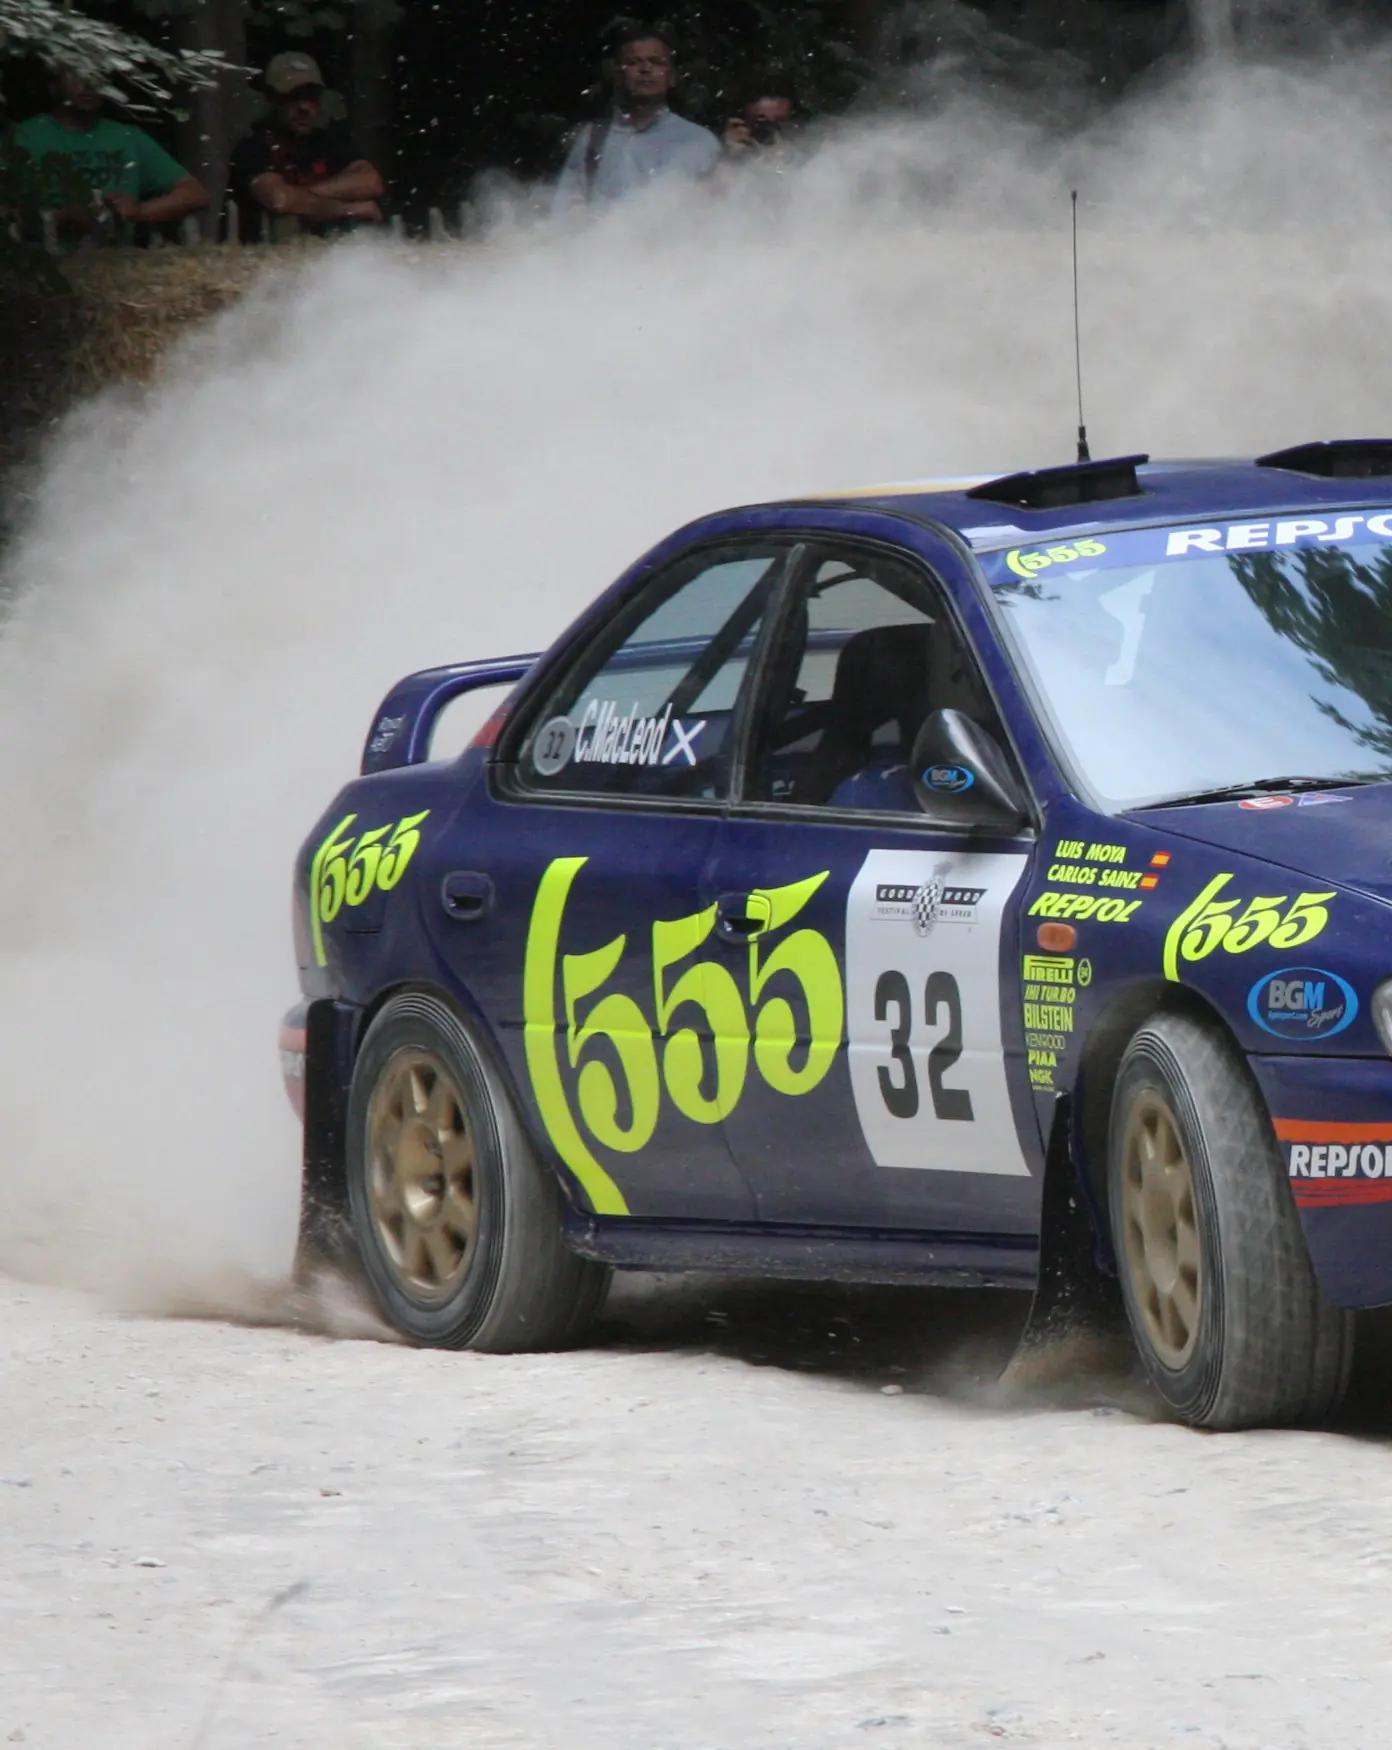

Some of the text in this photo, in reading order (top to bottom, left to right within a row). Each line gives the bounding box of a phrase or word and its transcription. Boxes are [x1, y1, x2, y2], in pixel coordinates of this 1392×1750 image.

[1020, 539, 1107, 573] 555
[542, 730, 566, 760] 32
[317, 809, 430, 924] 555
[1055, 840, 1127, 864] LUIS MOYA
[1047, 864, 1143, 889] CARLOS SAINZ
[880, 888, 915, 900] GOOD
[1027, 892, 1143, 923] REPSOL
[1175, 886, 1338, 966] 555
[1023, 955, 1075, 984] PIRELLI
[1040, 986, 1076, 1004] TURBO
[1268, 980, 1325, 1010] BGM
[562, 870, 844, 1154] 555
[1023, 1002, 1073, 1032] BILSTEIN
[1307, 1004, 1344, 1029] Sport
[875, 970, 975, 1121] 32
[1028, 1049, 1057, 1067] PIAA
[1029, 1068, 1054, 1085] NGK
